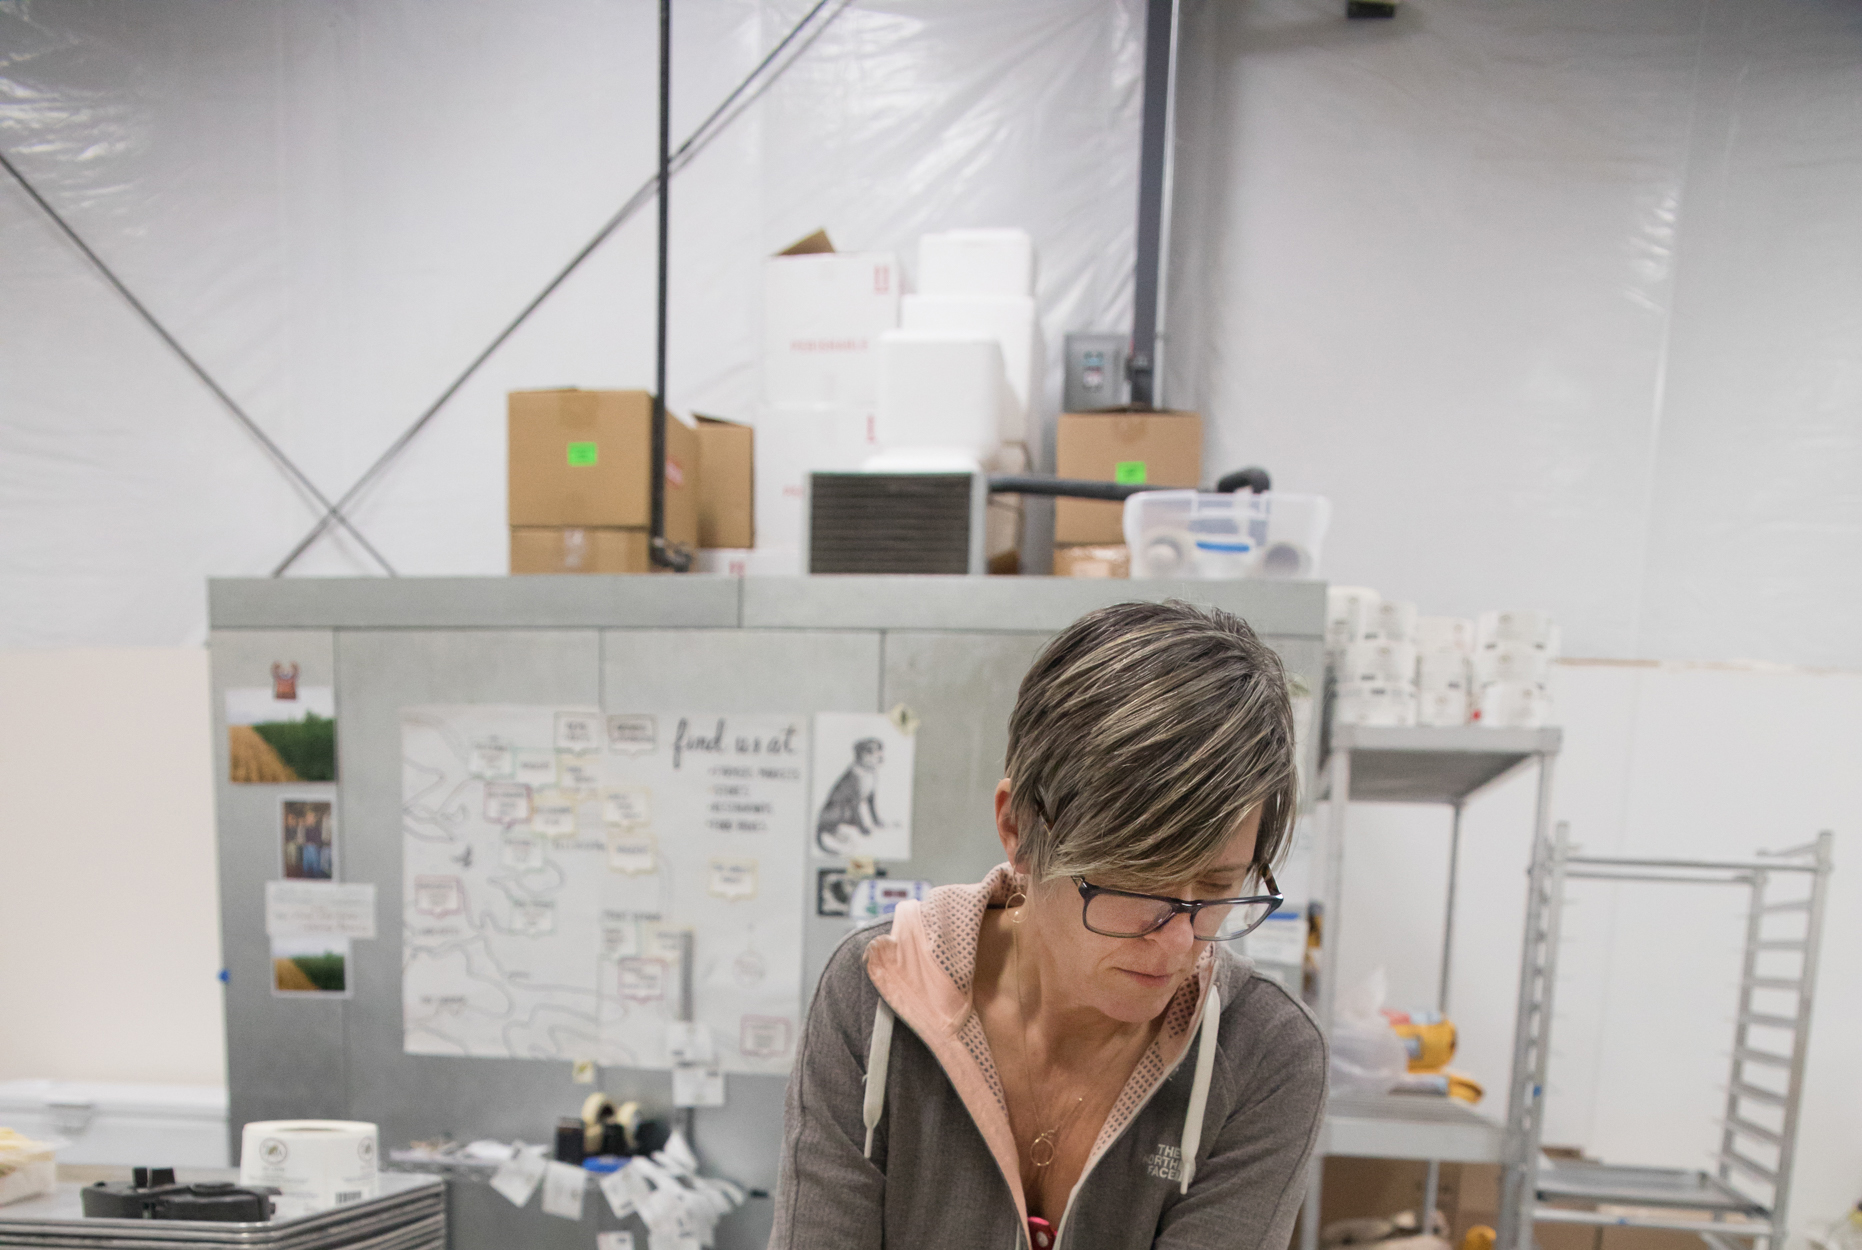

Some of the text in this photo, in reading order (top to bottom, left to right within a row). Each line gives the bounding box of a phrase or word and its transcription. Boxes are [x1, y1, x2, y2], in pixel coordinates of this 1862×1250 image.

[673, 717, 726, 769] find
[735, 735, 761, 753] us
[766, 722, 797, 753] at
[1158, 1144, 1181, 1158] THE
[1147, 1165, 1177, 1180] FACE
